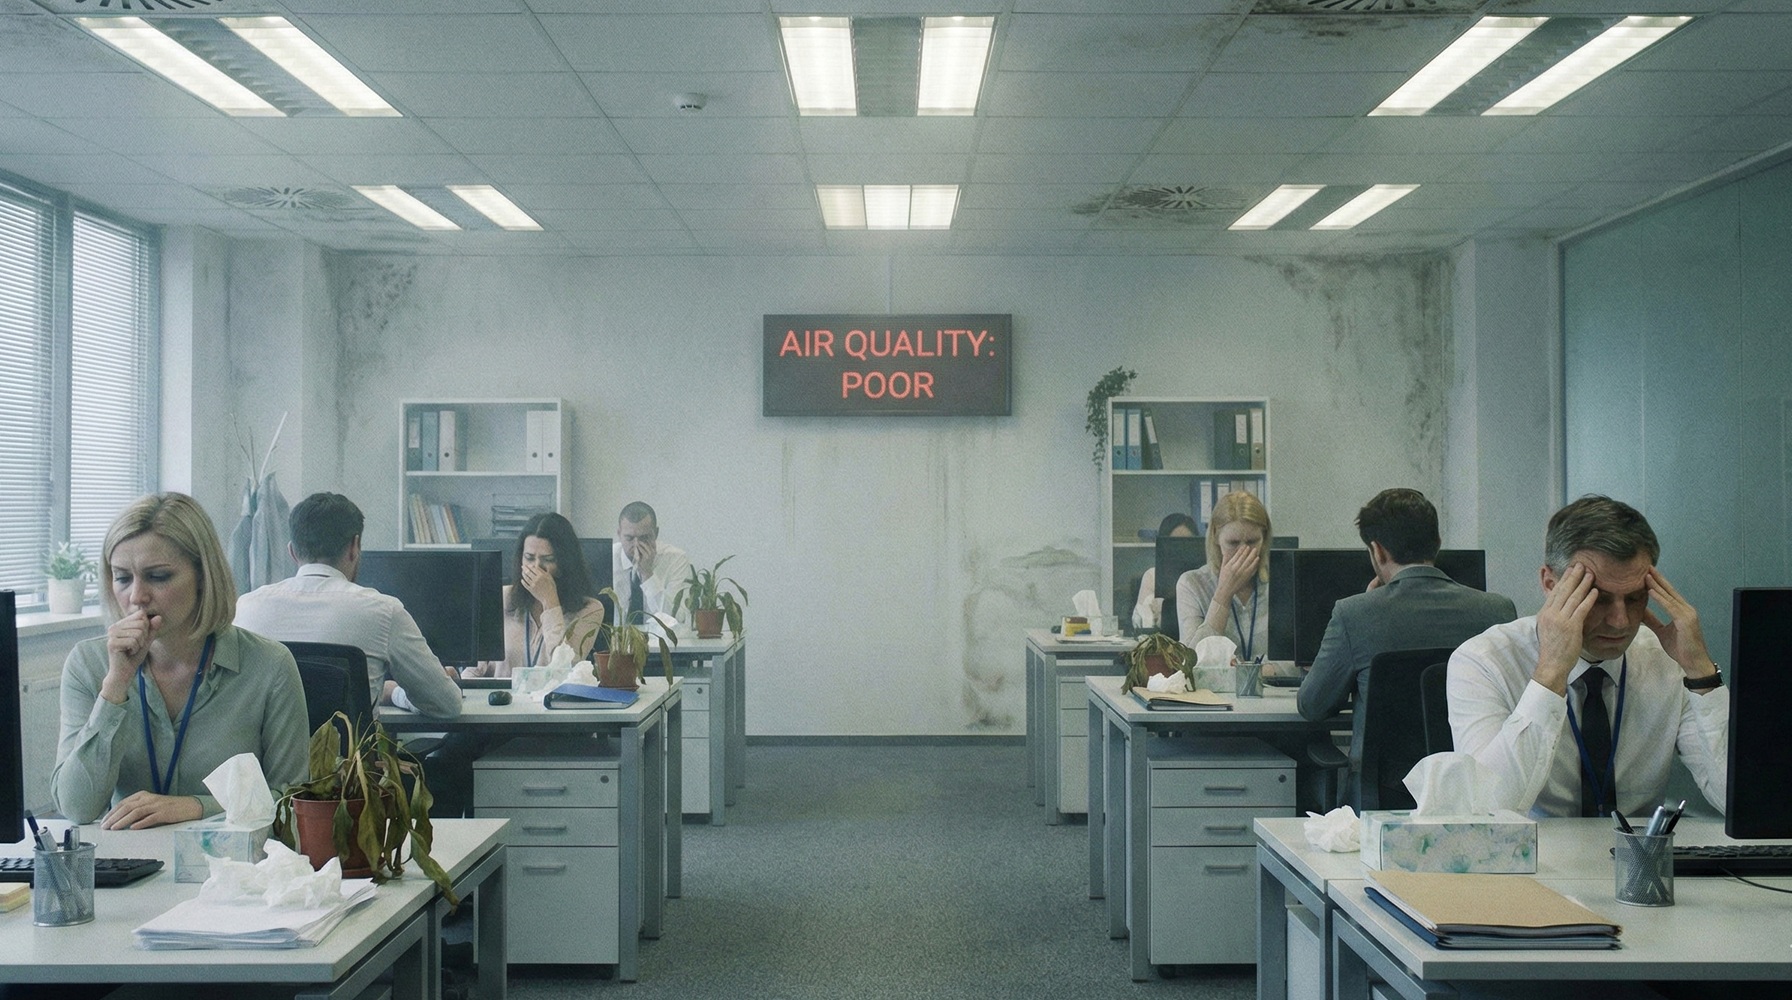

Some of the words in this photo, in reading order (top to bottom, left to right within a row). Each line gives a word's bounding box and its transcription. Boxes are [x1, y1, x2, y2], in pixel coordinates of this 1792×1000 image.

[779, 330, 834, 357] AIR
[844, 330, 995, 361] QUALITY:
[842, 371, 934, 398] POOR
